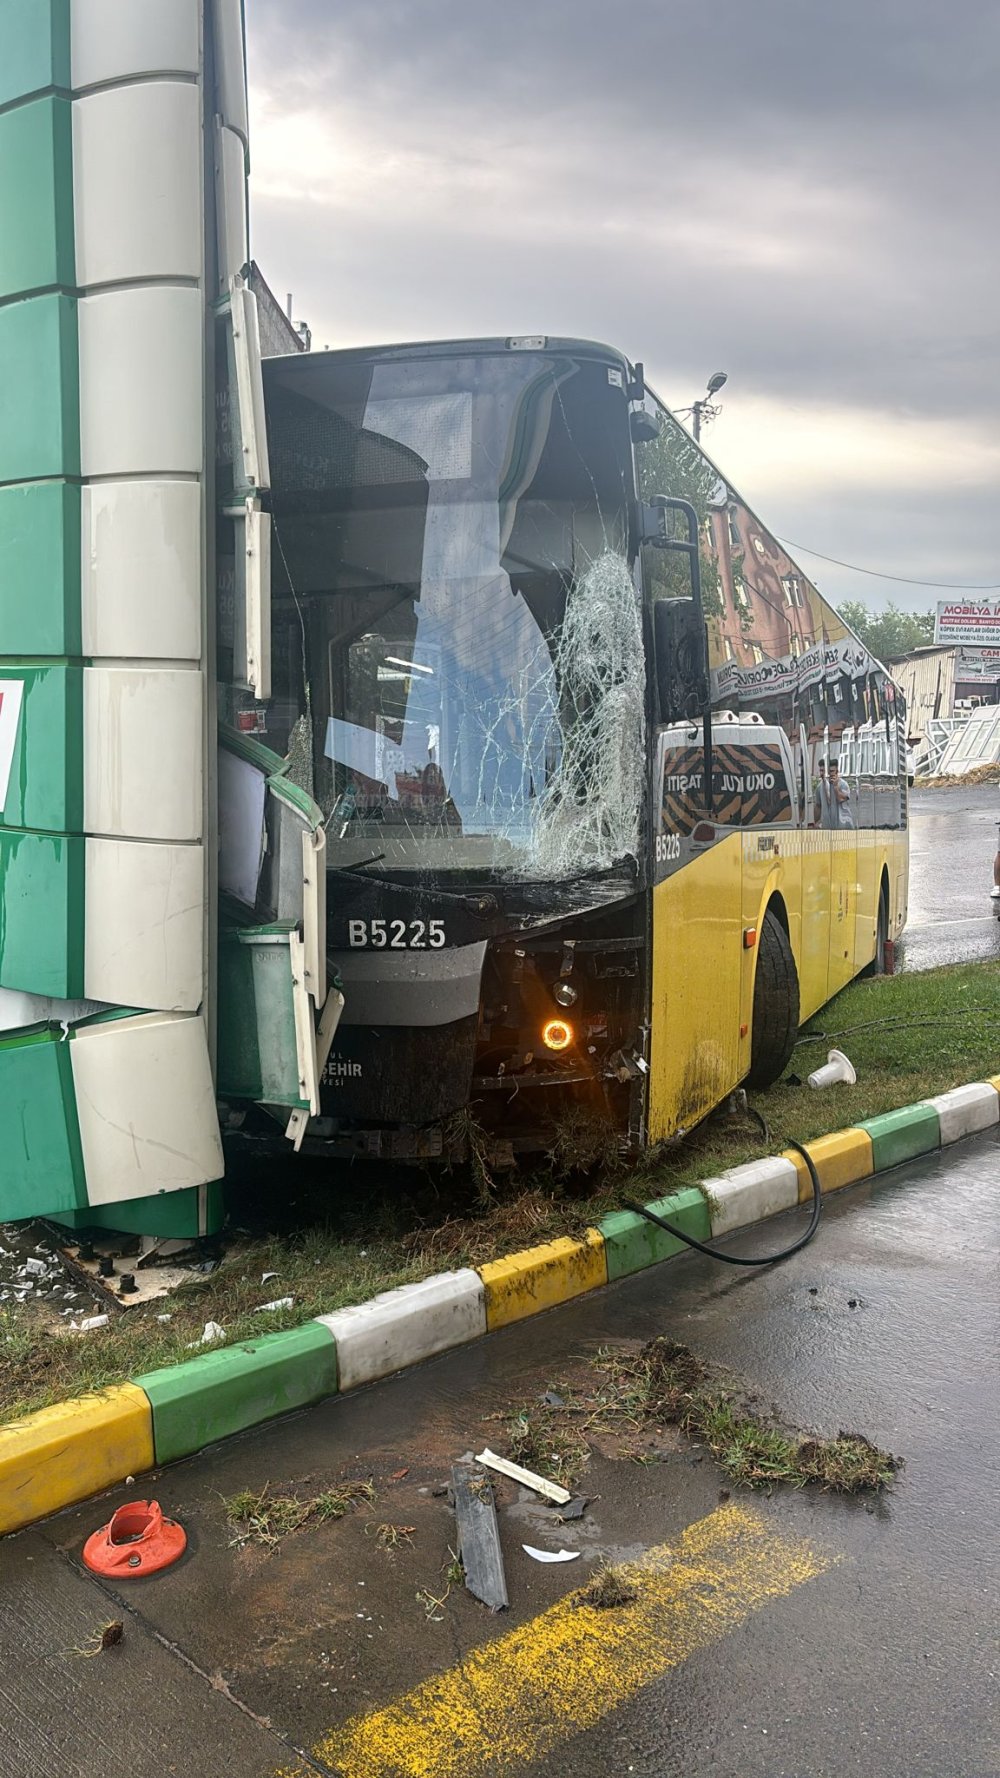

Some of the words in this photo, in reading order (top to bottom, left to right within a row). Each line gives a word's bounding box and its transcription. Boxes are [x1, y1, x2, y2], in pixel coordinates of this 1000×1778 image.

[944, 604, 991, 616] MOBİLYA
[980, 649, 1000, 657] CAM
[656, 833, 680, 862] B5225
[349, 919, 446, 948] B5225
